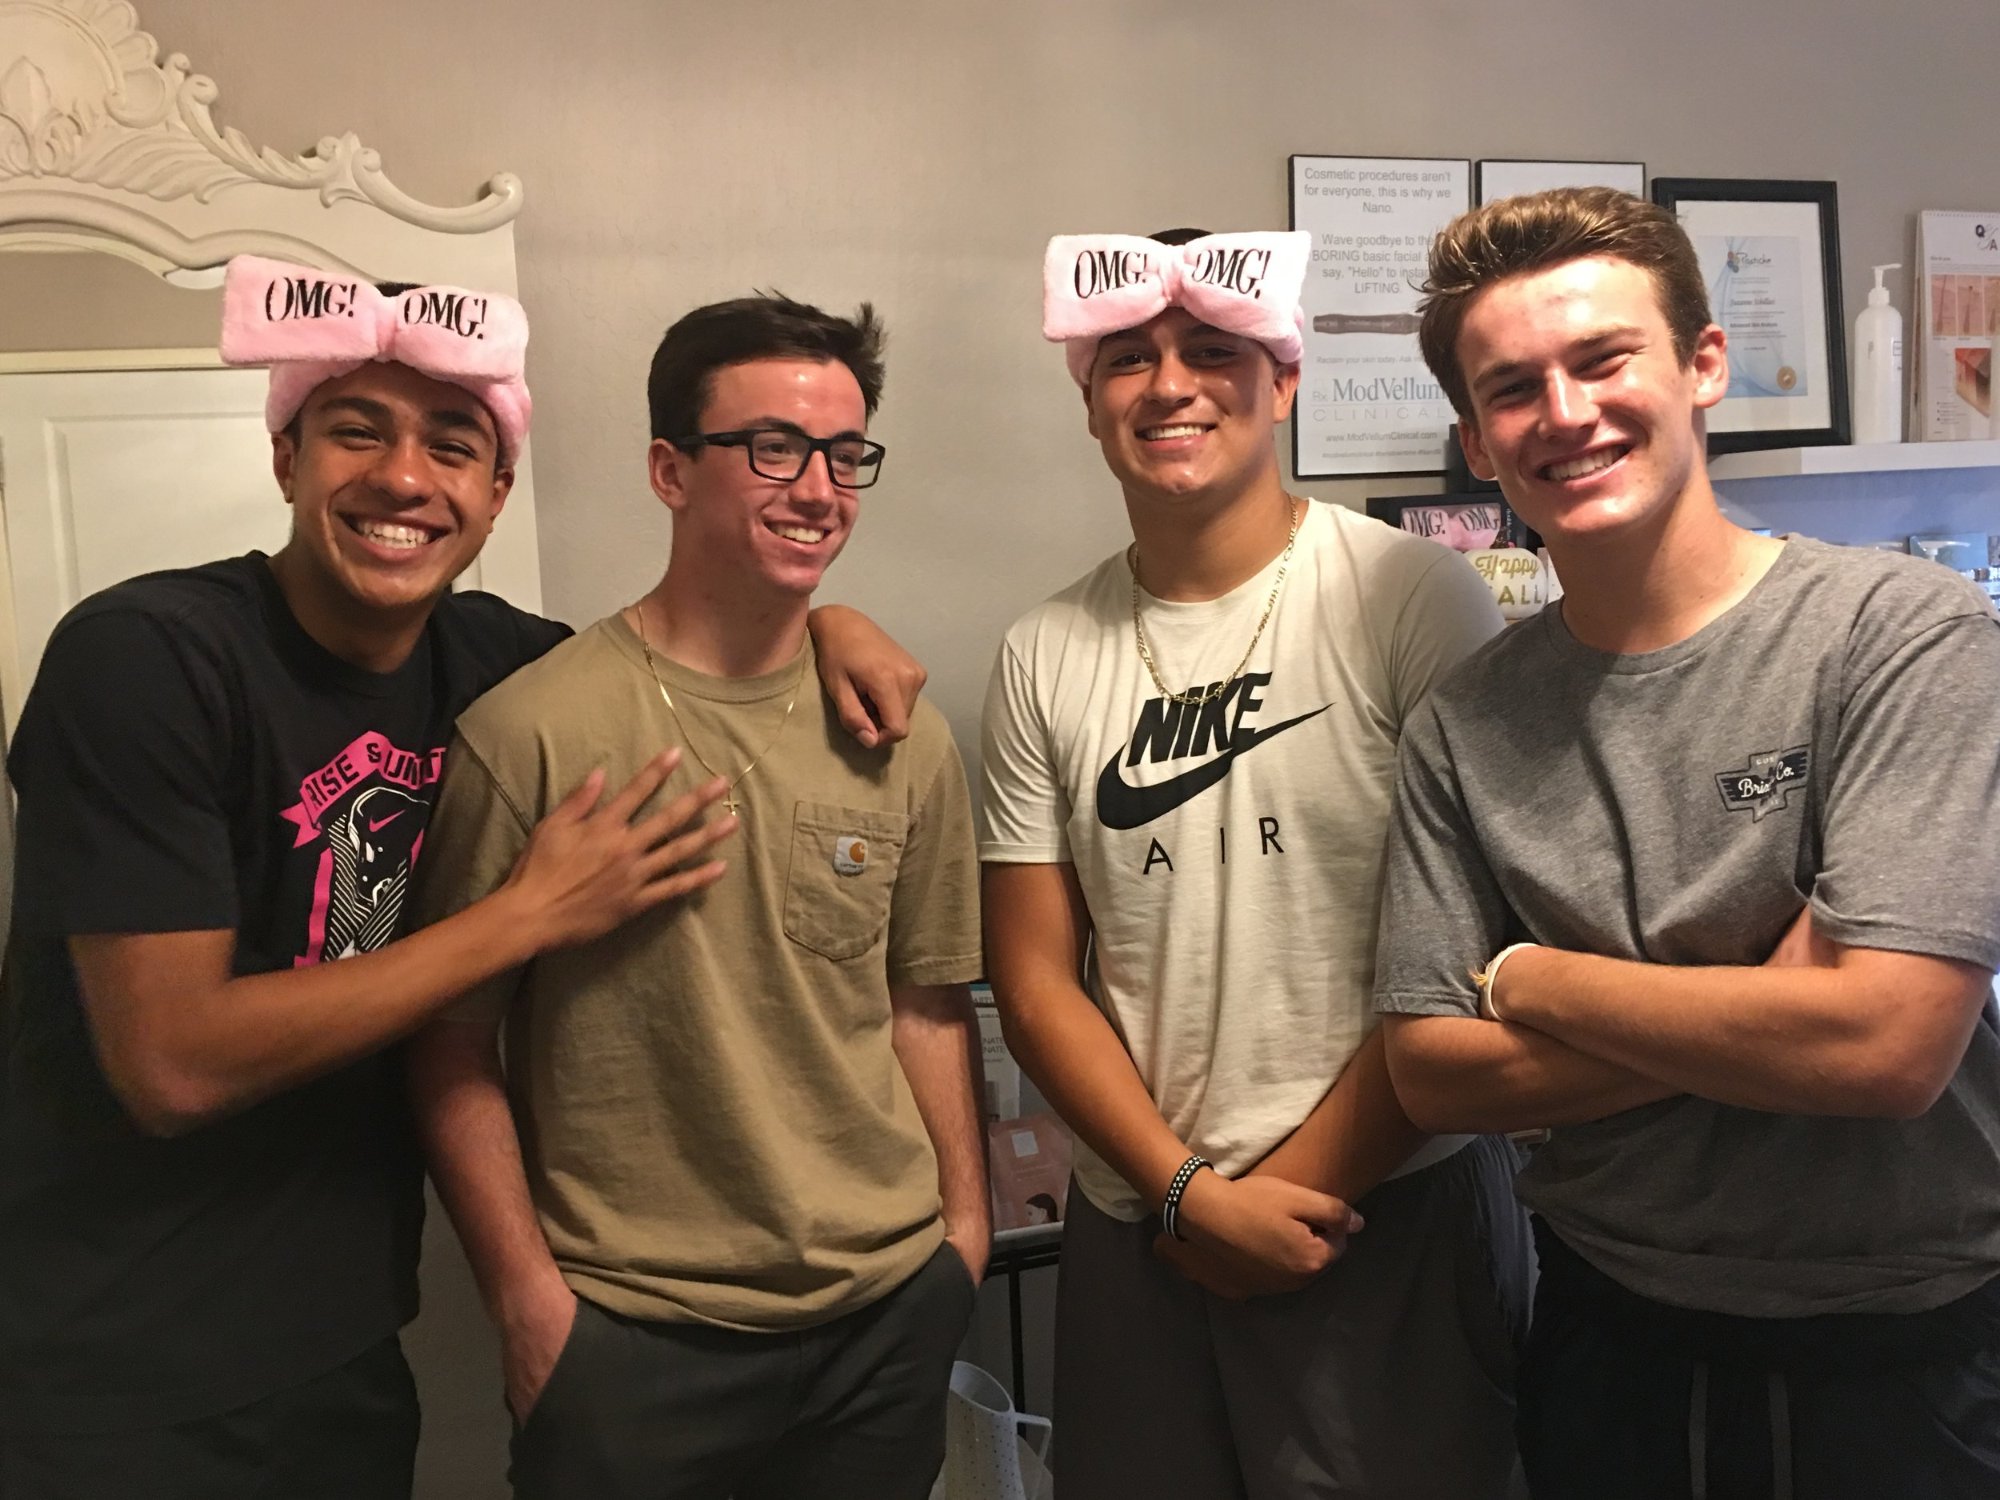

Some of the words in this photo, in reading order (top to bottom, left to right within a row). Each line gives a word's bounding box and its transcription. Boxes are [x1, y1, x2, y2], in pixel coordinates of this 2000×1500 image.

[1304, 167, 1356, 180] Cosmetic
[1358, 170, 1418, 182] procedures
[1421, 171, 1451, 182] aren't
[1304, 184, 1319, 196] for
[1378, 186, 1397, 198] this
[1400, 186, 1409, 198] is
[1411, 186, 1433, 200] why
[1436, 188, 1451, 198] we
[1362, 201, 1394, 214] Nano.
[1321, 233, 1353, 246] Wave
[1356, 234, 1401, 248] goodbye
[1404, 235, 1415, 246] to
[1417, 234, 1433, 246] the
[1311, 249, 1360, 261] BORING
[1362, 250, 1391, 262] basic
[1394, 250, 1421, 262] facial
[1074, 249, 1148, 300] OMG!
[1190, 248, 1272, 300] OMG!
[1386, 267, 1397, 278] to
[265, 276, 357, 323] OMG!
[403, 292, 488, 340] OMG!
[1332, 376, 1448, 402] ModVellum
[1312, 406, 1446, 421] CLINICAL
[1475, 554, 1539, 580] Happy
[1489, 584, 1542, 606] ALL
[1126, 671, 1273, 768] NIKE
[305, 753, 361, 808] RISE
[1143, 816, 1285, 875] AIR
